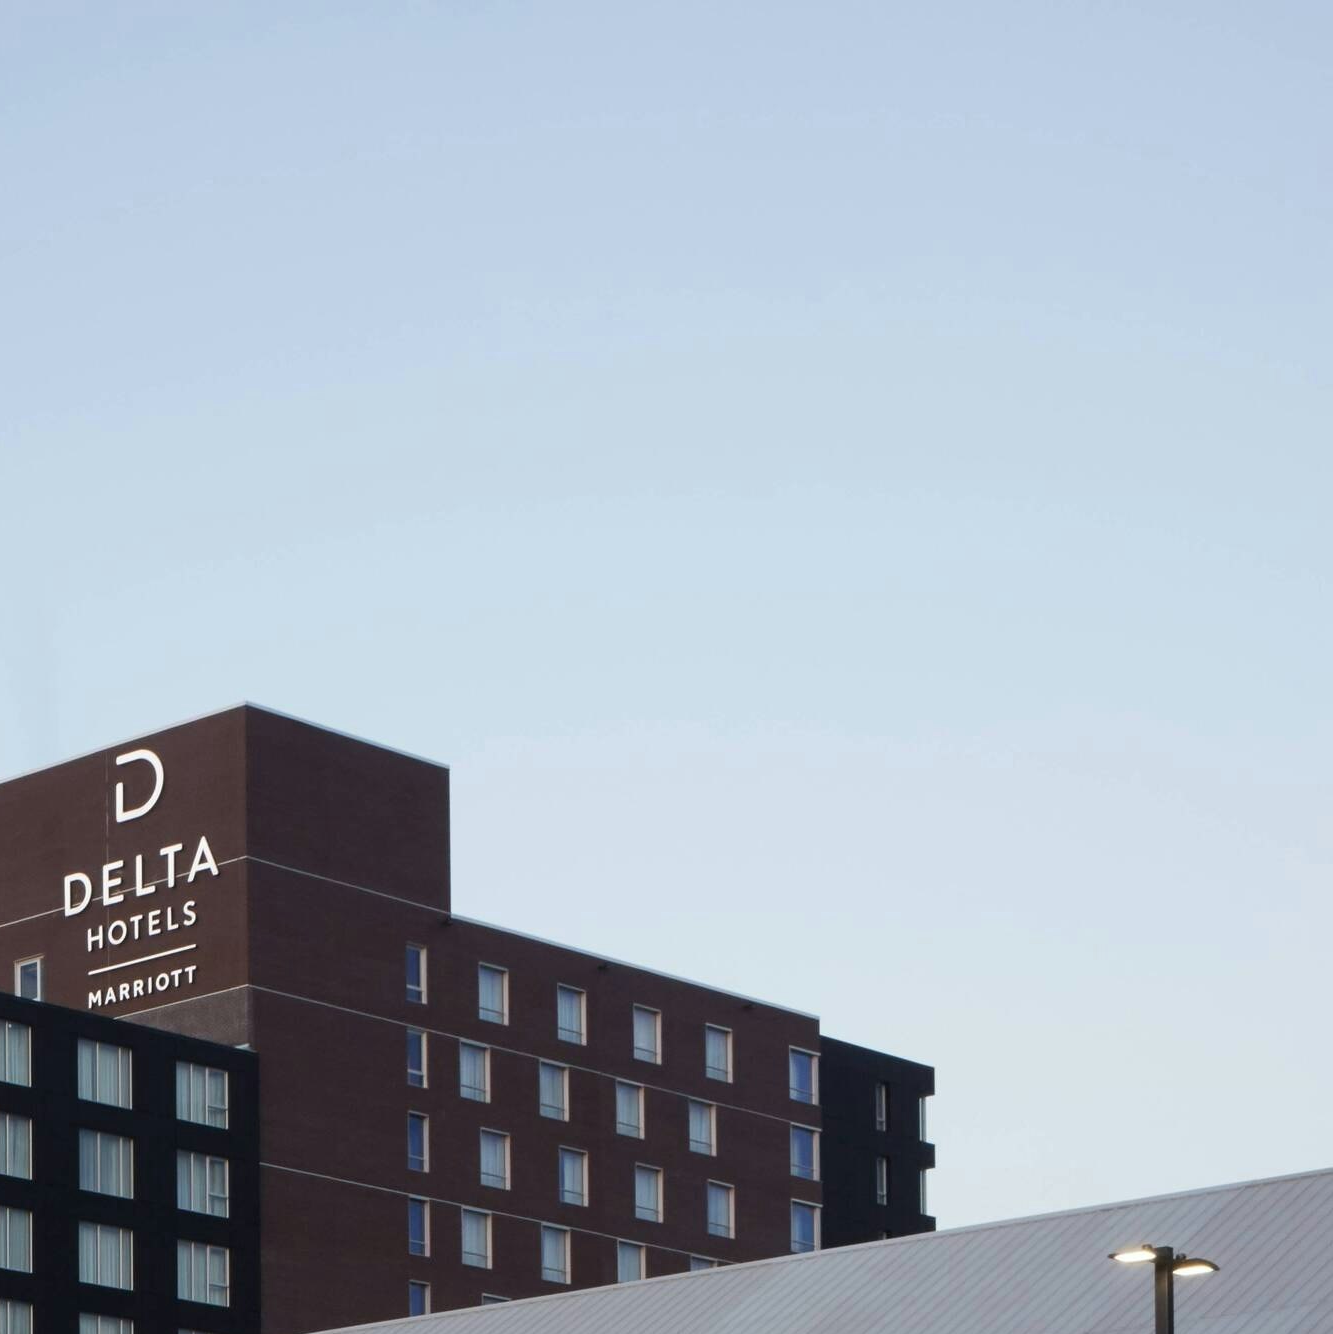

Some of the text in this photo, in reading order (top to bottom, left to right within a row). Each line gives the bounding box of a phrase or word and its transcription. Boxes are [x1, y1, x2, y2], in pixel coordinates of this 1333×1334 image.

[64, 835, 219, 917] DELTA
[87, 900, 197, 952] HOTELS
[88, 965, 197, 1009] MARRIOTT
